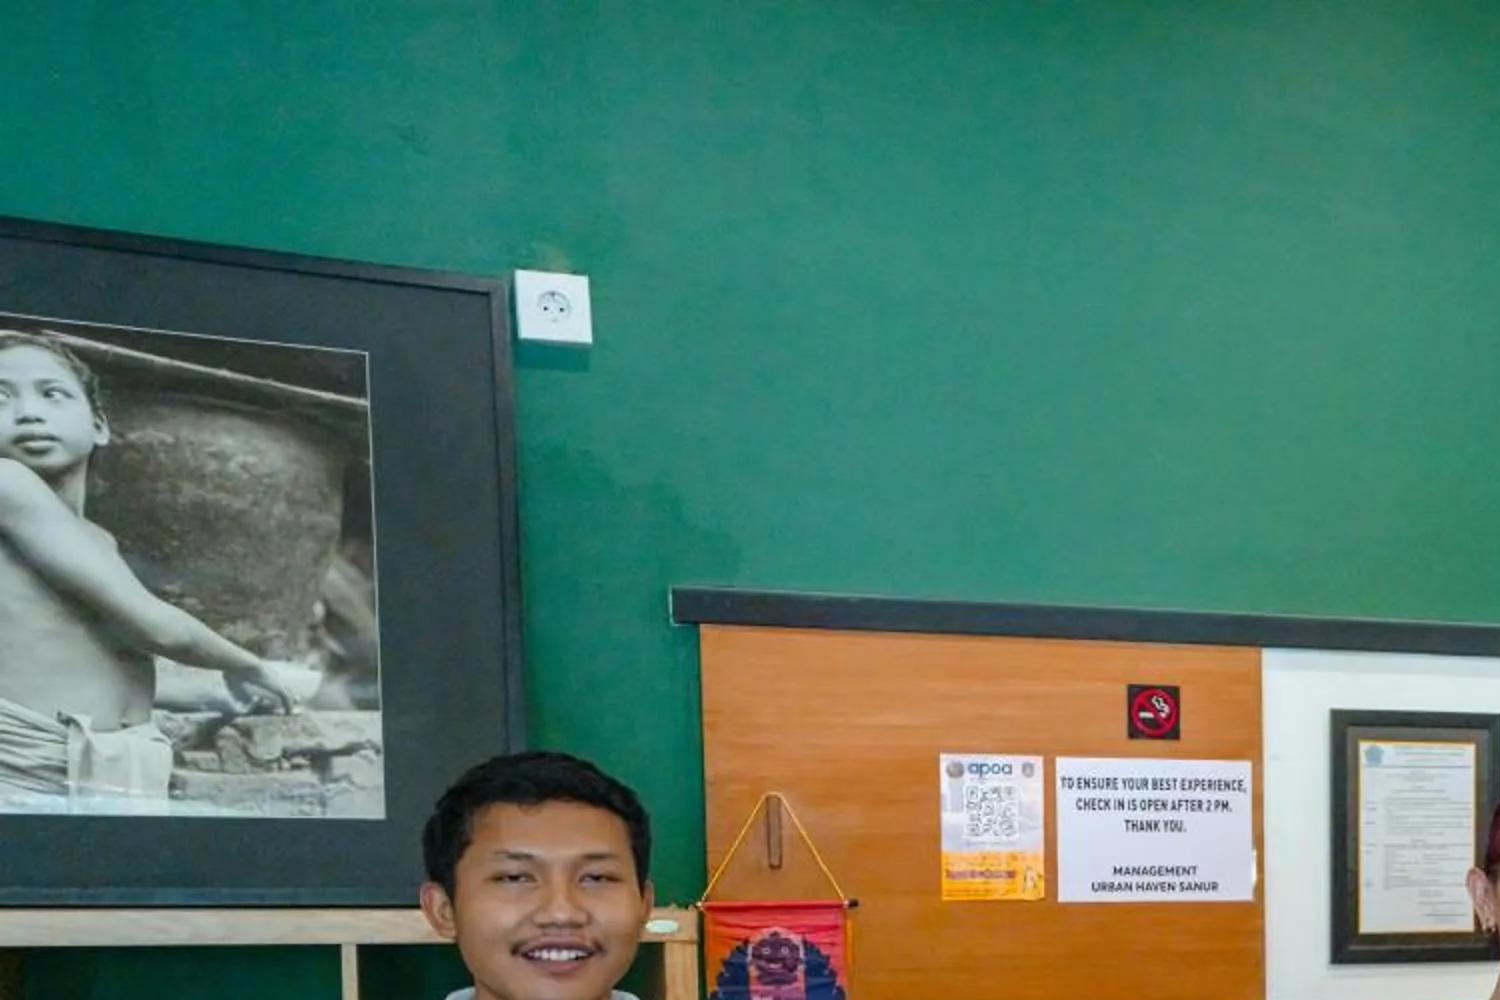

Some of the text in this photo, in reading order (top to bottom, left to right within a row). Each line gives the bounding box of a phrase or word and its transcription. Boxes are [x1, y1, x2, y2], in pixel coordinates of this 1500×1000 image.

[1061, 777, 1247, 793] TO ENSURE YOUR BEST EXPERIENCE,
[1076, 798, 1233, 813] CHECK IN IS OPEN AFTER 2 PM.
[1124, 819, 1187, 833] THANK YOU.
[1113, 865, 1197, 876] MANAGEMENT
[1091, 881, 1219, 893] URBAN HAVEN SANUR
